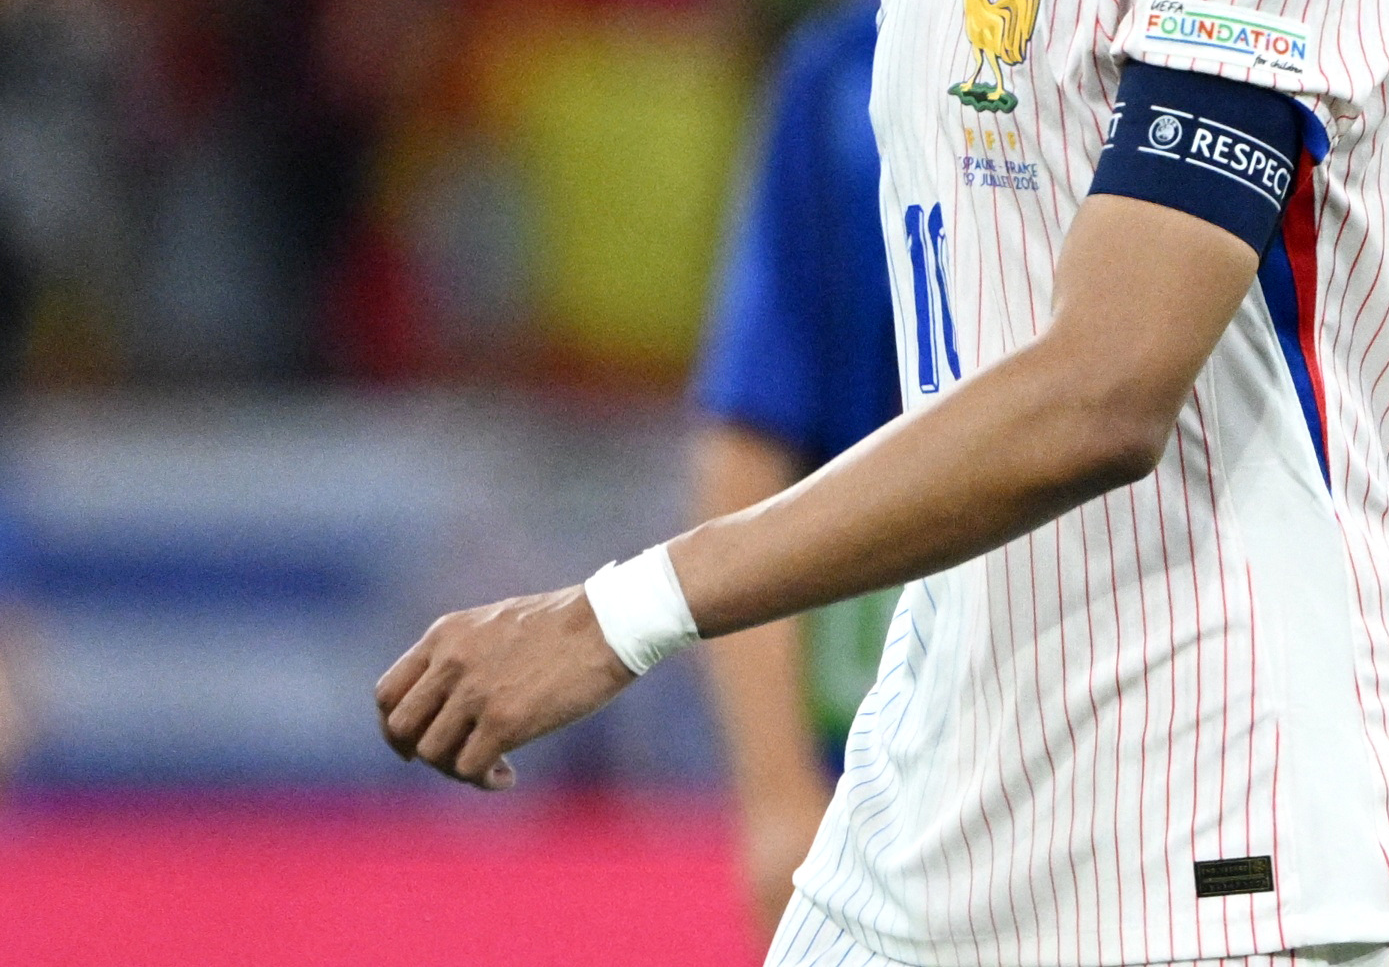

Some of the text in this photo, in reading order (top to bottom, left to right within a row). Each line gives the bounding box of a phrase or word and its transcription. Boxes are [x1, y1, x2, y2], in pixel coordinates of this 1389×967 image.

[1150, 0, 1184, 14] UEFA
[1146, 14, 1306, 60] FOUNDATION
[1252, 54, 1303, 74] for children
